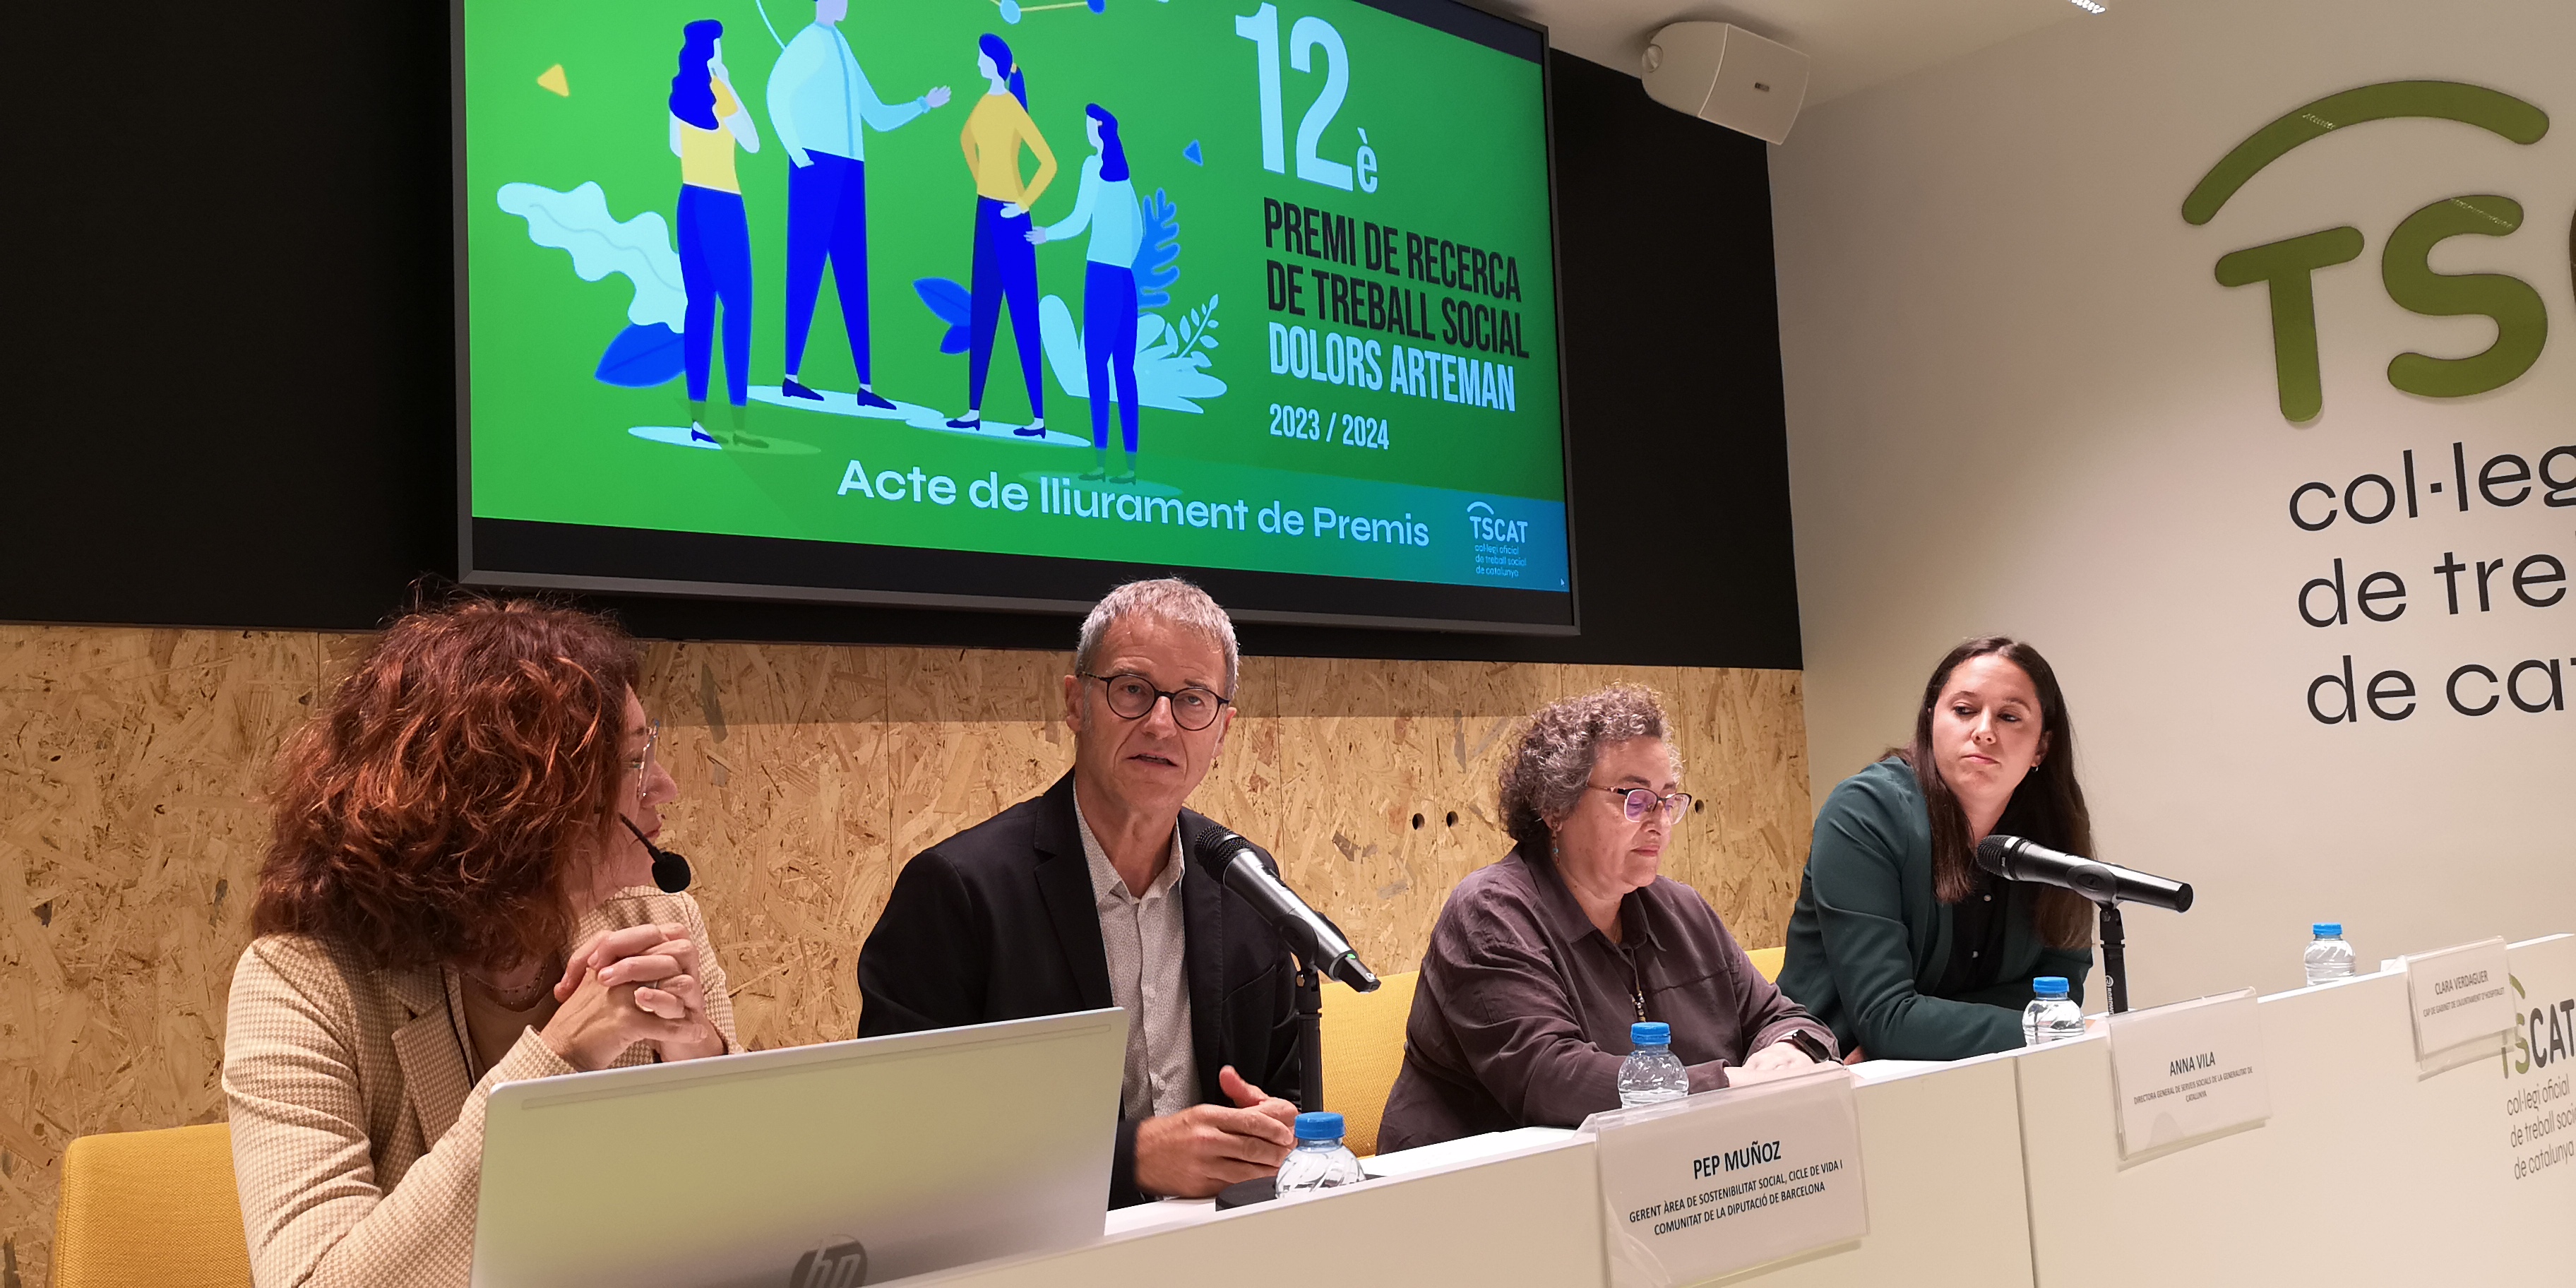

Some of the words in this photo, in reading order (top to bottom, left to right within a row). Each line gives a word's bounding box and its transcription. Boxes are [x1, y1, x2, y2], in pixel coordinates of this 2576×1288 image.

[1263, 197, 1356, 266] PREMI
[1364, 222, 1400, 275] DE
[1406, 232, 1522, 303] RECERCA
[1267, 259, 1306, 316] DE
[1311, 269, 1436, 340] TREBALL
[1441, 297, 1530, 358] SOCIAL
[2215, 195, 2576, 422] TS
[1269, 322, 1383, 391] DOLORS
[1390, 345, 1515, 412] ARTEMAN
[1270, 403, 1320, 440] 2023
[1326, 412, 1336, 442] /
[1342, 414, 1389, 450] 2024
[837, 460, 957, 506] Acte
[969, 472, 1029, 511] de
[1040, 477, 1248, 530] lliurament
[1257, 500, 1304, 536] de
[1314, 507, 1430, 547] Premis
[1469, 516, 1528, 543] TSCAT
[1475, 554, 1484, 563] de
[1485, 555, 1506, 564] treball
[1508, 557, 1527, 566] social
[1499, 545, 1519, 555] oficial
[1476, 565, 1485, 574] de
[1486, 566, 1519, 578] catalunya
[2298, 558, 2407, 628] de
[2307, 655, 2416, 724] de
[2446, 657, 2576, 717] ca
[2435, 979, 2454, 995] CLARA
[2453, 970, 2488, 990] VERDAGUER
[2170, 1056, 2195, 1076] ANNA
[2196, 1051, 2216, 1070] VILA
[2134, 1092, 2157, 1104] DIRECTORA
[2157, 1087, 2175, 1098] GENERAL
[2181, 1081, 2196, 1092] SERVEIS
[2196, 1077, 2212, 1087] SOCIALS
[2223, 1068, 2248, 1080] GENERALITAT
[2186, 1090, 2207, 1102] CATALUNYA
[2542, 1073, 2570, 1103] oficial
[2510, 1125, 2524, 1147] de
[2524, 1111, 2555, 1142] treball
[1693, 1155, 1720, 1179] PEP
[1724, 1140, 1781, 1171] MUÑOZ
[2514, 1157, 2527, 1180] de
[2528, 1140, 2575, 1174] catalunya
[1629, 1204, 1662, 1223] GERENT
[1664, 1200, 1686, 1215] ÀREA
[1687, 1195, 1698, 1208] DE
[1699, 1180, 1757, 1205] SOSTENIBILITAT
[1758, 1174, 1788, 1189] SOCIAL,
[1789, 1169, 1808, 1182] CICLE
[1809, 1165, 1820, 1176] DE
[1821, 1160, 1839, 1174] VIDA
[1840, 1159, 1844, 1169] I
[1654, 1212, 1703, 1236] COMUNITAT
[1704, 1210, 1715, 1222] DE
[1716, 1207, 1727, 1219] LA
[1727, 1194, 1767, 1217] DIPUTACIÓ
[1769, 1193, 1779, 1205] DE
[1781, 1181, 1825, 1202] BARCELONA
